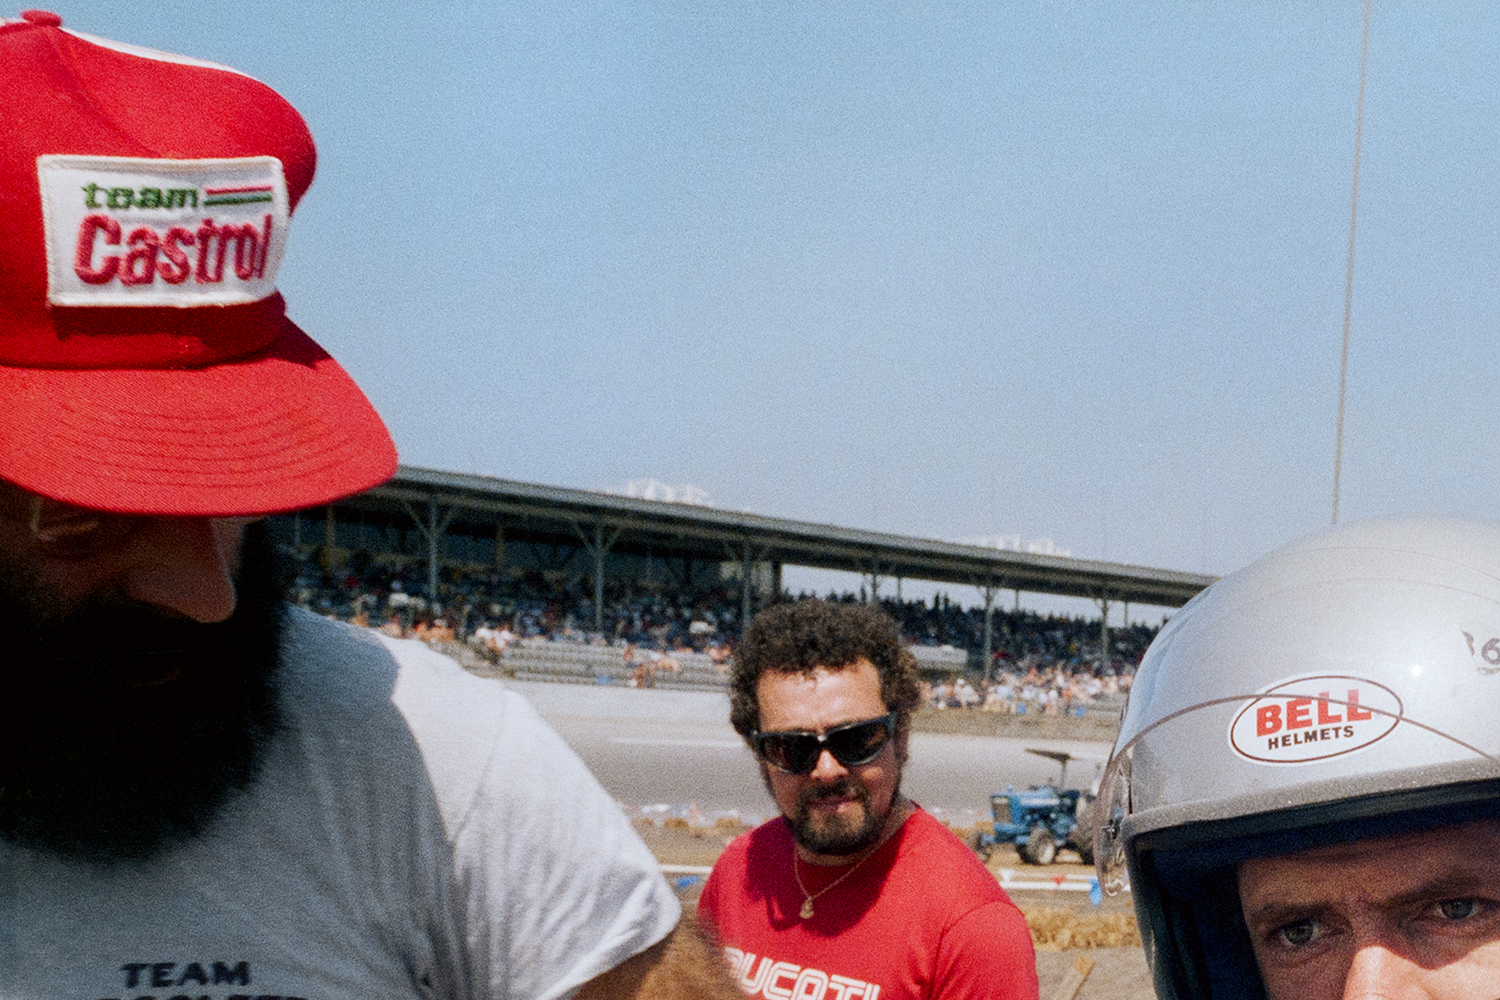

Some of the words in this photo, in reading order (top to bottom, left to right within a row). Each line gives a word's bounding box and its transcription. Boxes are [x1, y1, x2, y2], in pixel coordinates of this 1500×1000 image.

[82, 182, 199, 210] team
[74, 213, 273, 286] Castrol
[1256, 688, 1372, 738] BELL
[1268, 725, 1354, 750] HELMETS
[121, 961, 250, 989] TEAM
